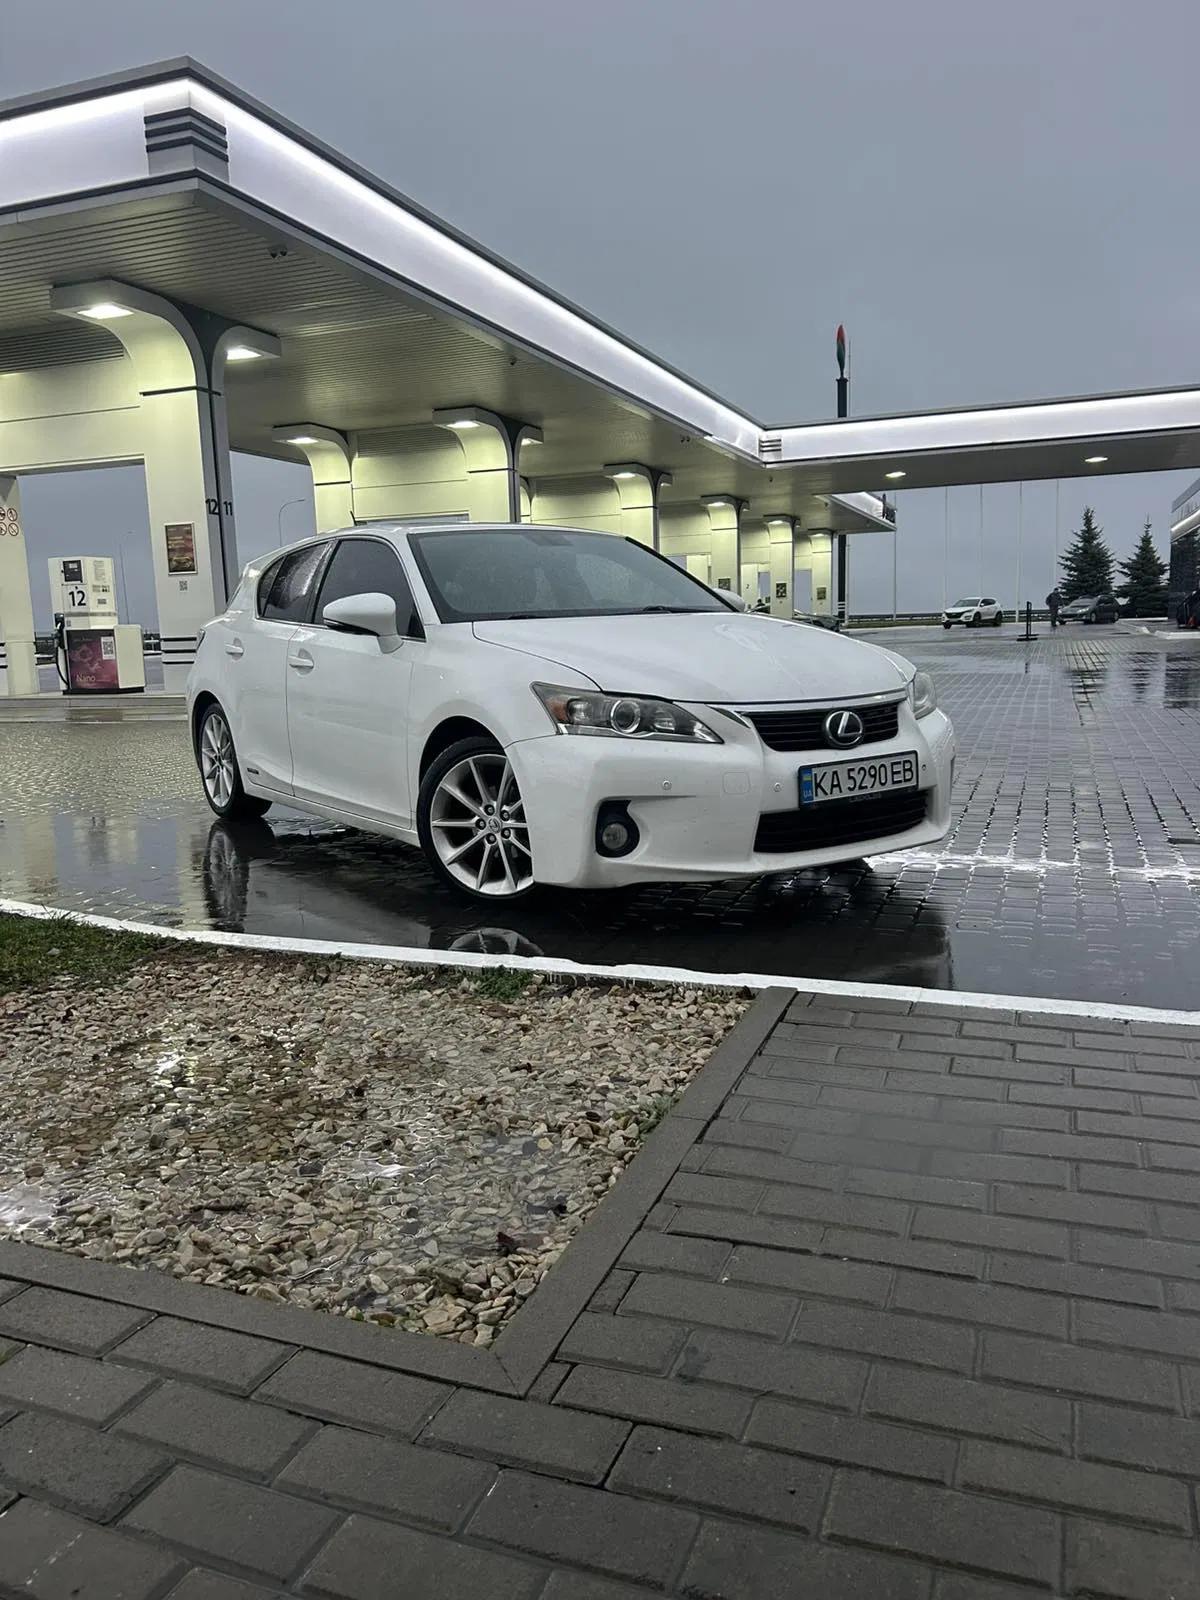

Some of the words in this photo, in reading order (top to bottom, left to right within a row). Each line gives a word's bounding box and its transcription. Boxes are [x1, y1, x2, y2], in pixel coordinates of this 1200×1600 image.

[205, 498, 220, 515] 12
[223, 500, 233, 516] 11
[68, 590, 86, 607] 12
[814, 770, 843, 797] KA
[847, 764, 887, 791] 5290
[891, 760, 914, 785] EB
